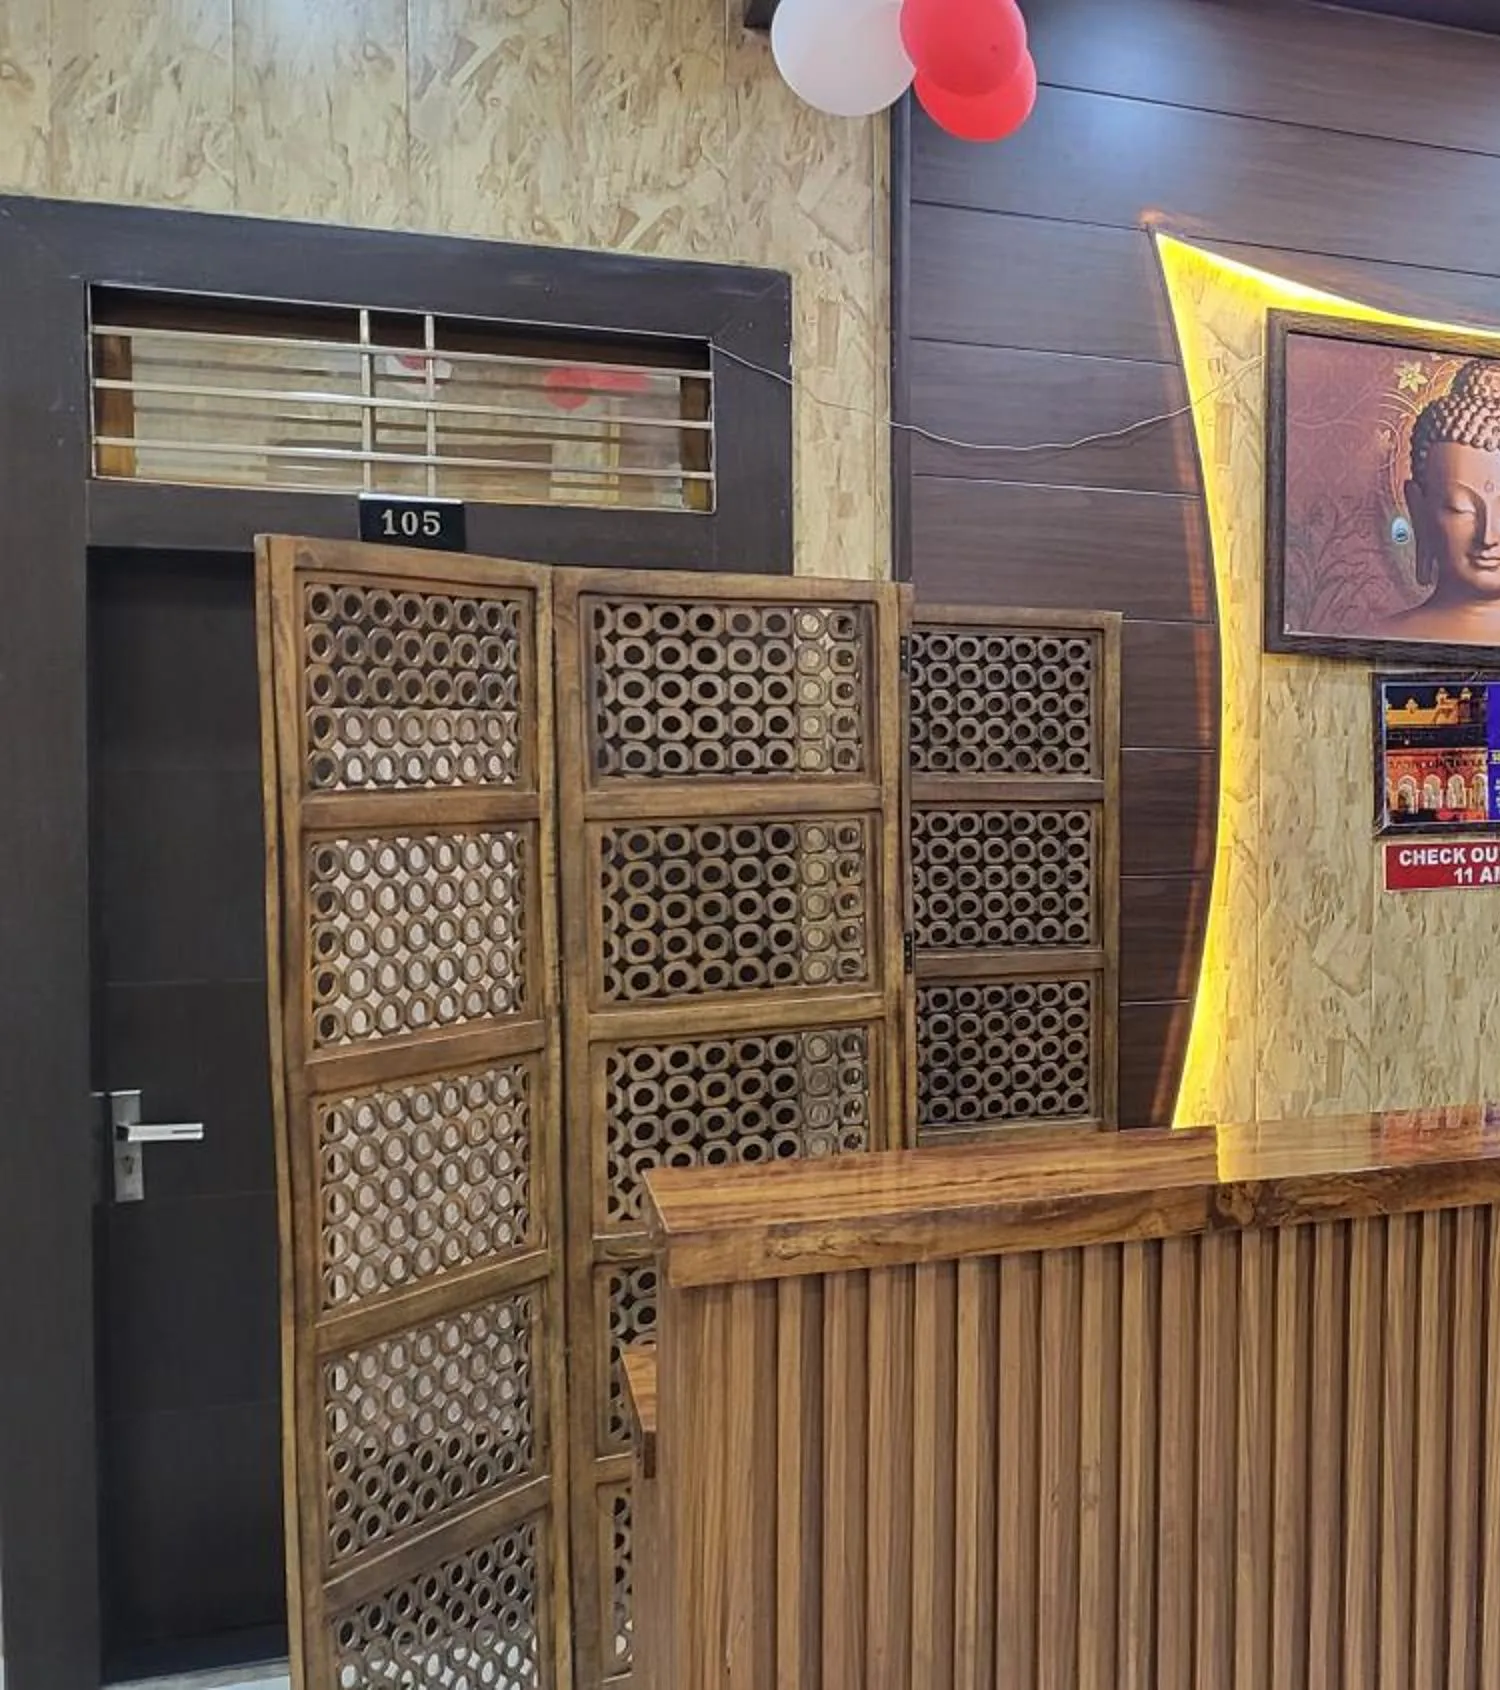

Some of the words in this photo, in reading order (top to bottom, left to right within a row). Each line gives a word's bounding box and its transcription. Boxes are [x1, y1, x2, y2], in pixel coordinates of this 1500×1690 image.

[381, 509, 440, 536] 105
[1399, 847, 1467, 866] CHECK
[1453, 867, 1473, 884] 11
